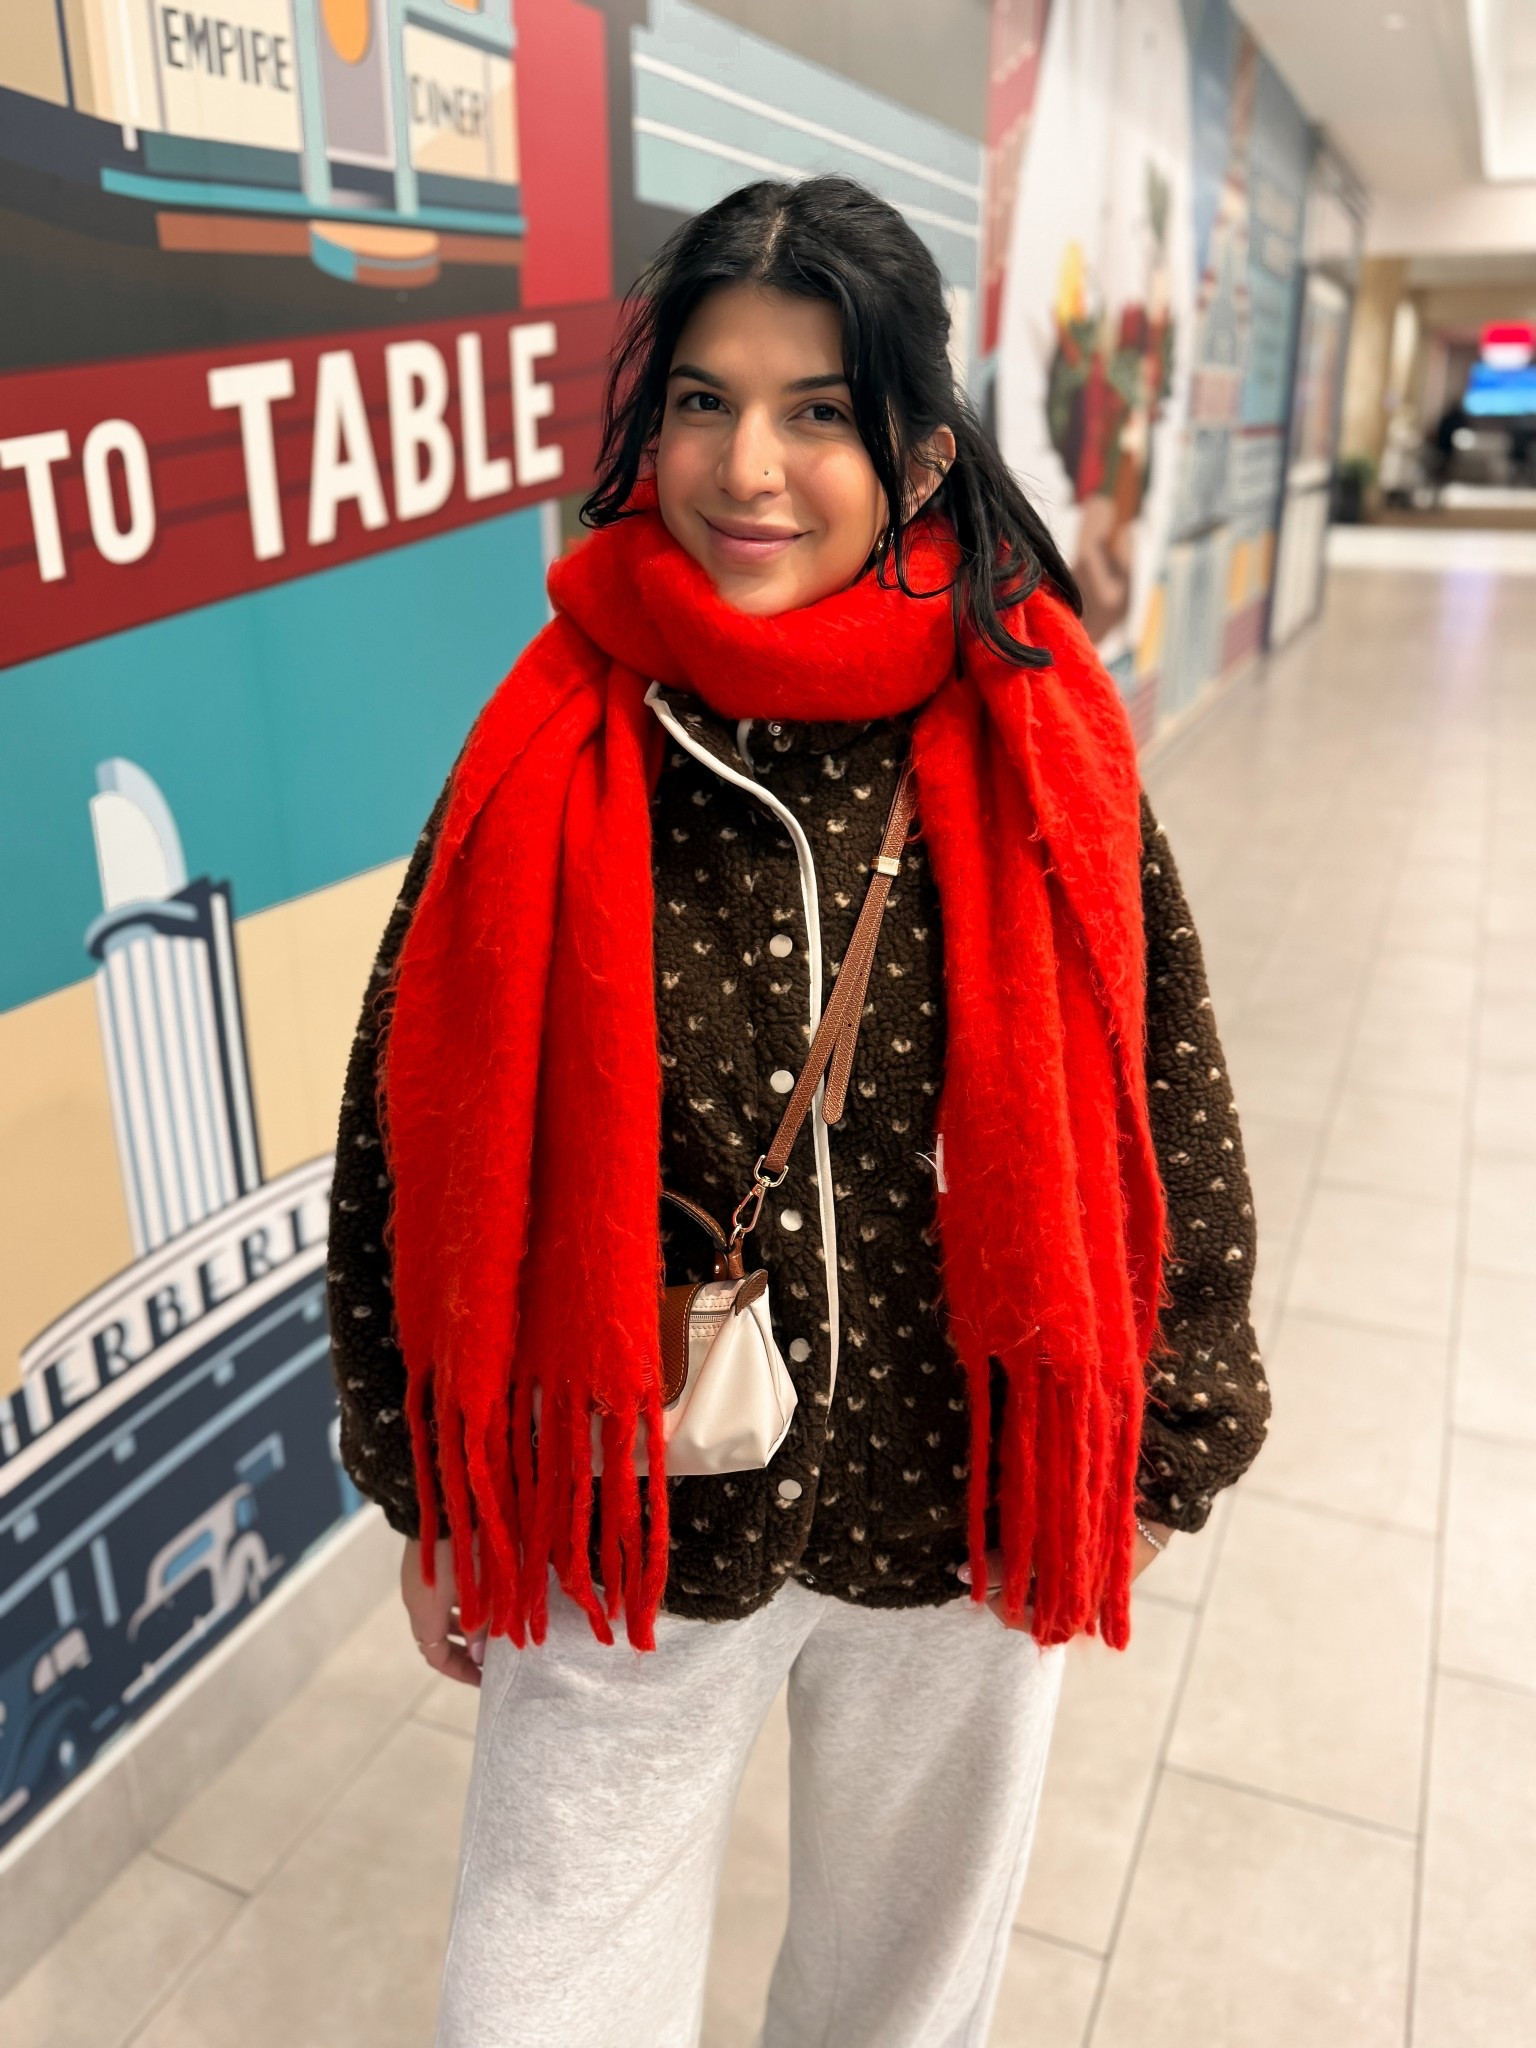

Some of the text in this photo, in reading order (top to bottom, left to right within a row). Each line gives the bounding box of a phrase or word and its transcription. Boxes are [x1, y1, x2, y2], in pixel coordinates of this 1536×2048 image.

[161, 7, 291, 92] EMPIRE
[0, 322, 563, 582] TO TABLE
